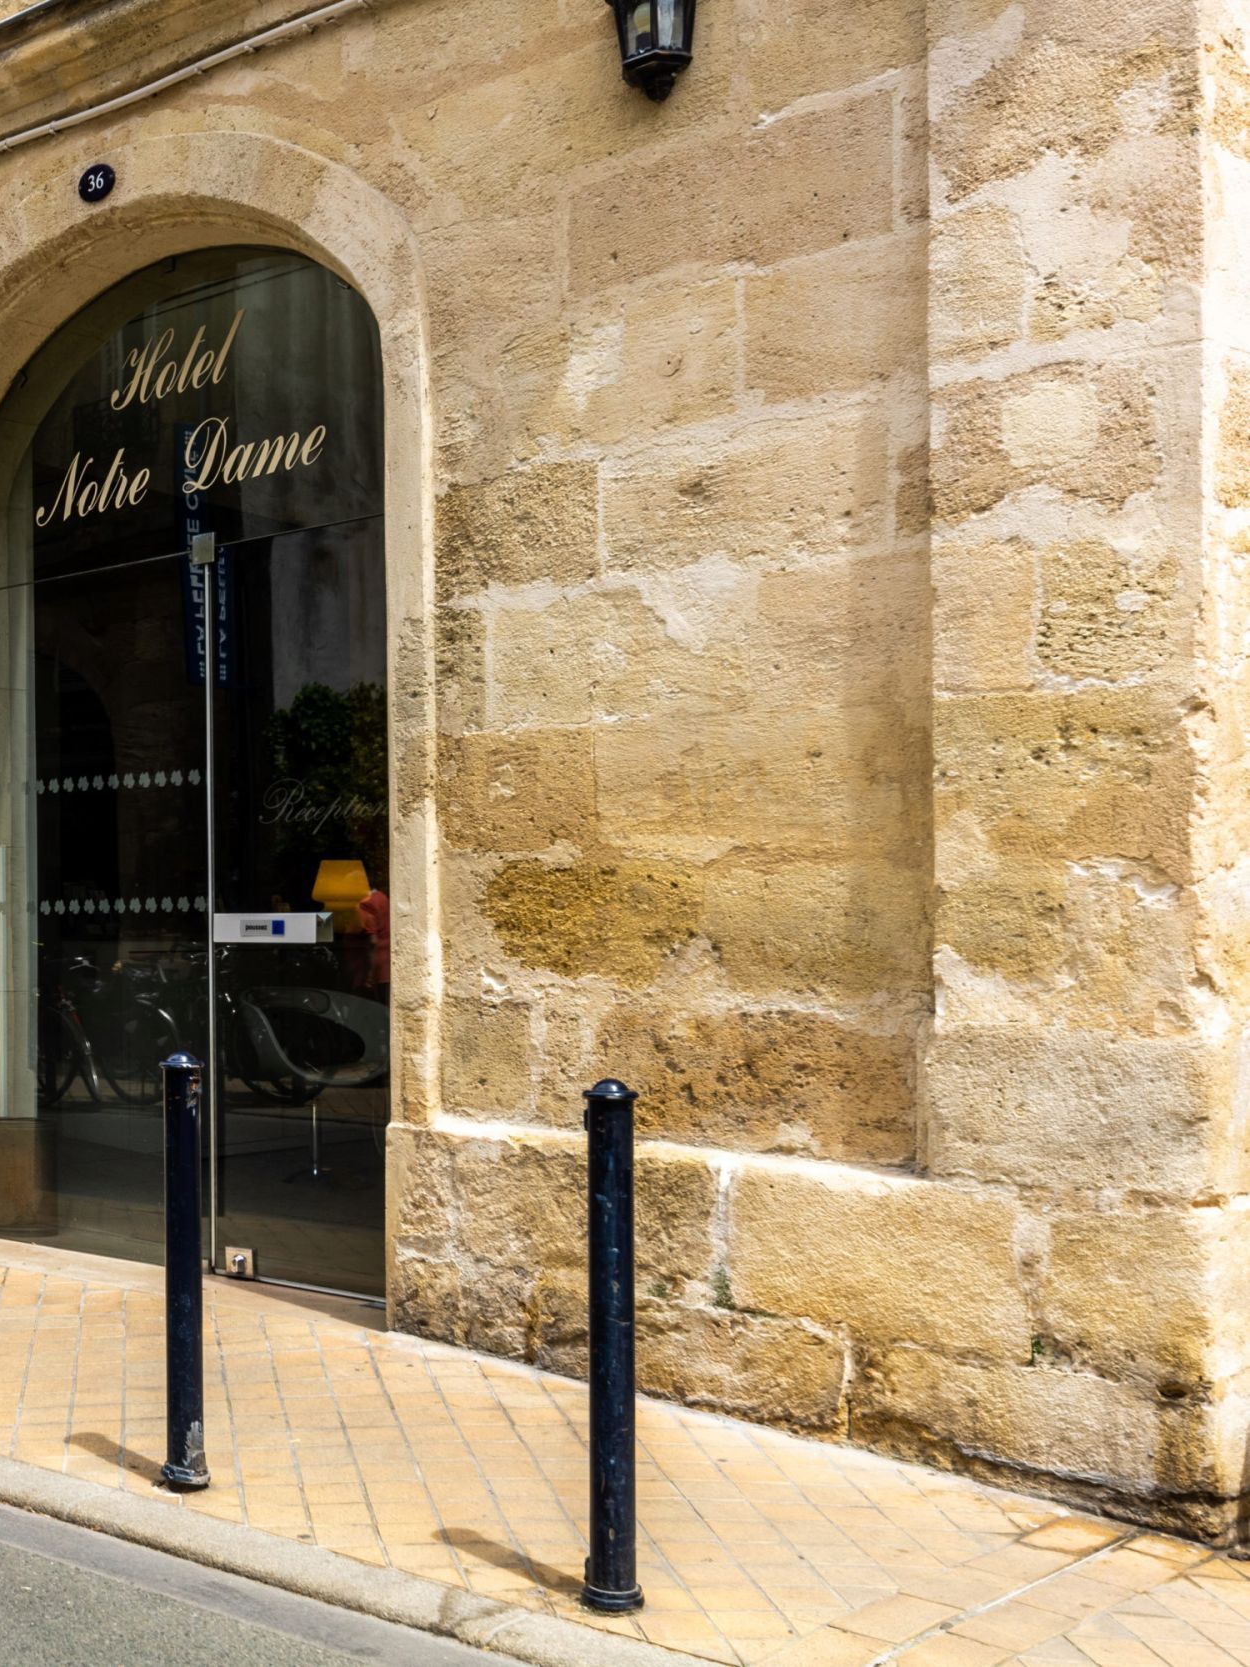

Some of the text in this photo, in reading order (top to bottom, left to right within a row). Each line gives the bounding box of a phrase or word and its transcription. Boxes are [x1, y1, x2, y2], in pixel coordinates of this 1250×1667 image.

[87, 171, 104, 192] 36
[111, 308, 245, 411] Hotel
[36, 417, 326, 527] Notre Dame
